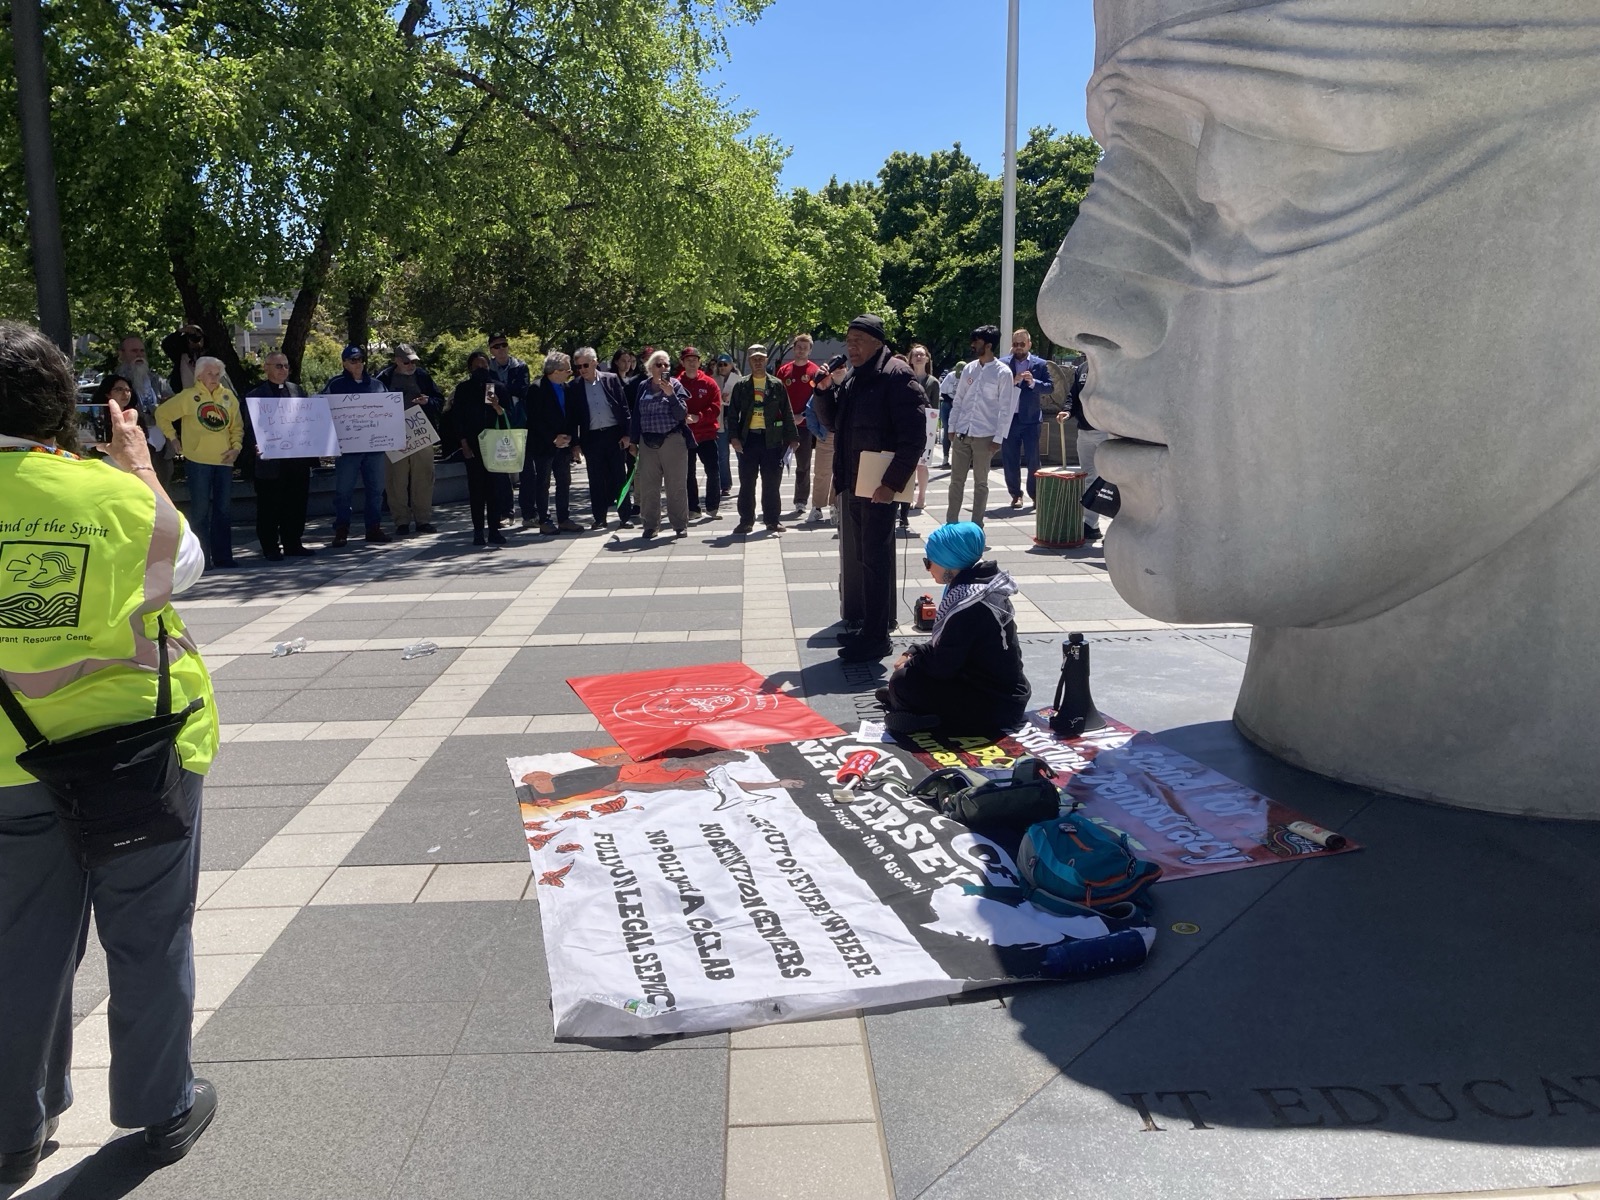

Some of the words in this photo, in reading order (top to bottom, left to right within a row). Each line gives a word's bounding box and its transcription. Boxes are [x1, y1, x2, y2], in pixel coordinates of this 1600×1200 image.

[257, 401, 273, 415] NO
[342, 394, 360, 402] NO
[404, 411, 427, 430] DHS
[413, 427, 427, 438] AND
[0, 518, 25, 533] ind
[25, 517, 43, 538] of
[44, 518, 66, 533] the
[70, 521, 110, 540] Spirit
[23, 634, 61, 644] Resource
[1010, 721, 1099, 772] storing
[1076, 769, 1254, 865] Democracy
[644, 829, 668, 851] NO
[609, 865, 640, 889] UN
[699, 822, 727, 842] NO
[747, 907, 812, 980] CENERS
[614, 886, 656, 953] LEGAL
[632, 951, 678, 1014] SERVIC
[1120, 1089, 1215, 1133] IT
